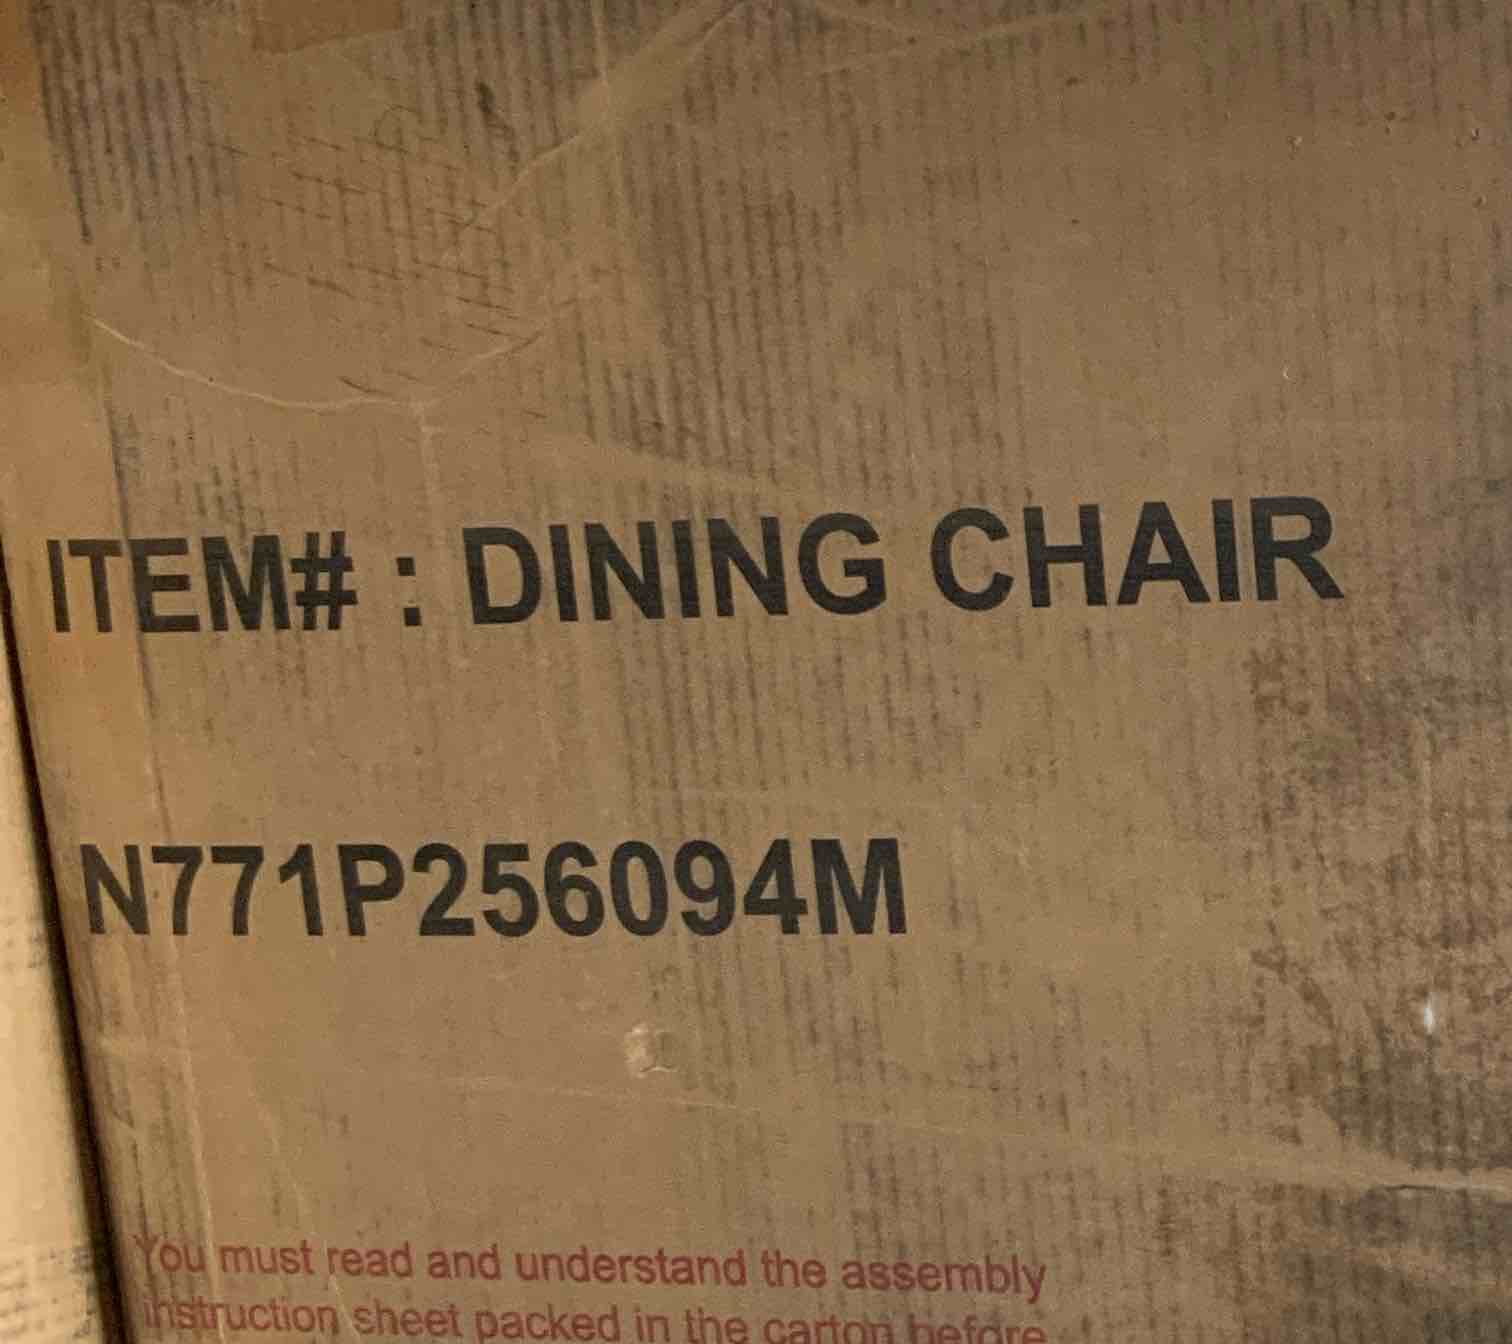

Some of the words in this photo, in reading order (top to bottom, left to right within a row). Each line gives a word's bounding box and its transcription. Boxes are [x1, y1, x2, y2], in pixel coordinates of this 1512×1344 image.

[45, 531, 359, 634] ITEM#
[462, 511, 888, 625] DINING
[930, 496, 1345, 612] CHAIR
[80, 837, 909, 938] N771P256094M
[134, 1234, 206, 1272] You
[221, 1240, 314, 1276] must
[326, 1240, 413, 1278] read
[428, 1243, 500, 1281] and
[515, 1246, 748, 1286] understand
[761, 1249, 827, 1288] the
[841, 1255, 1047, 1303] assembly
[143, 1296, 338, 1335] instruction
[353, 1299, 464, 1337] sheet
[635, 1308, 671, 1343] in
